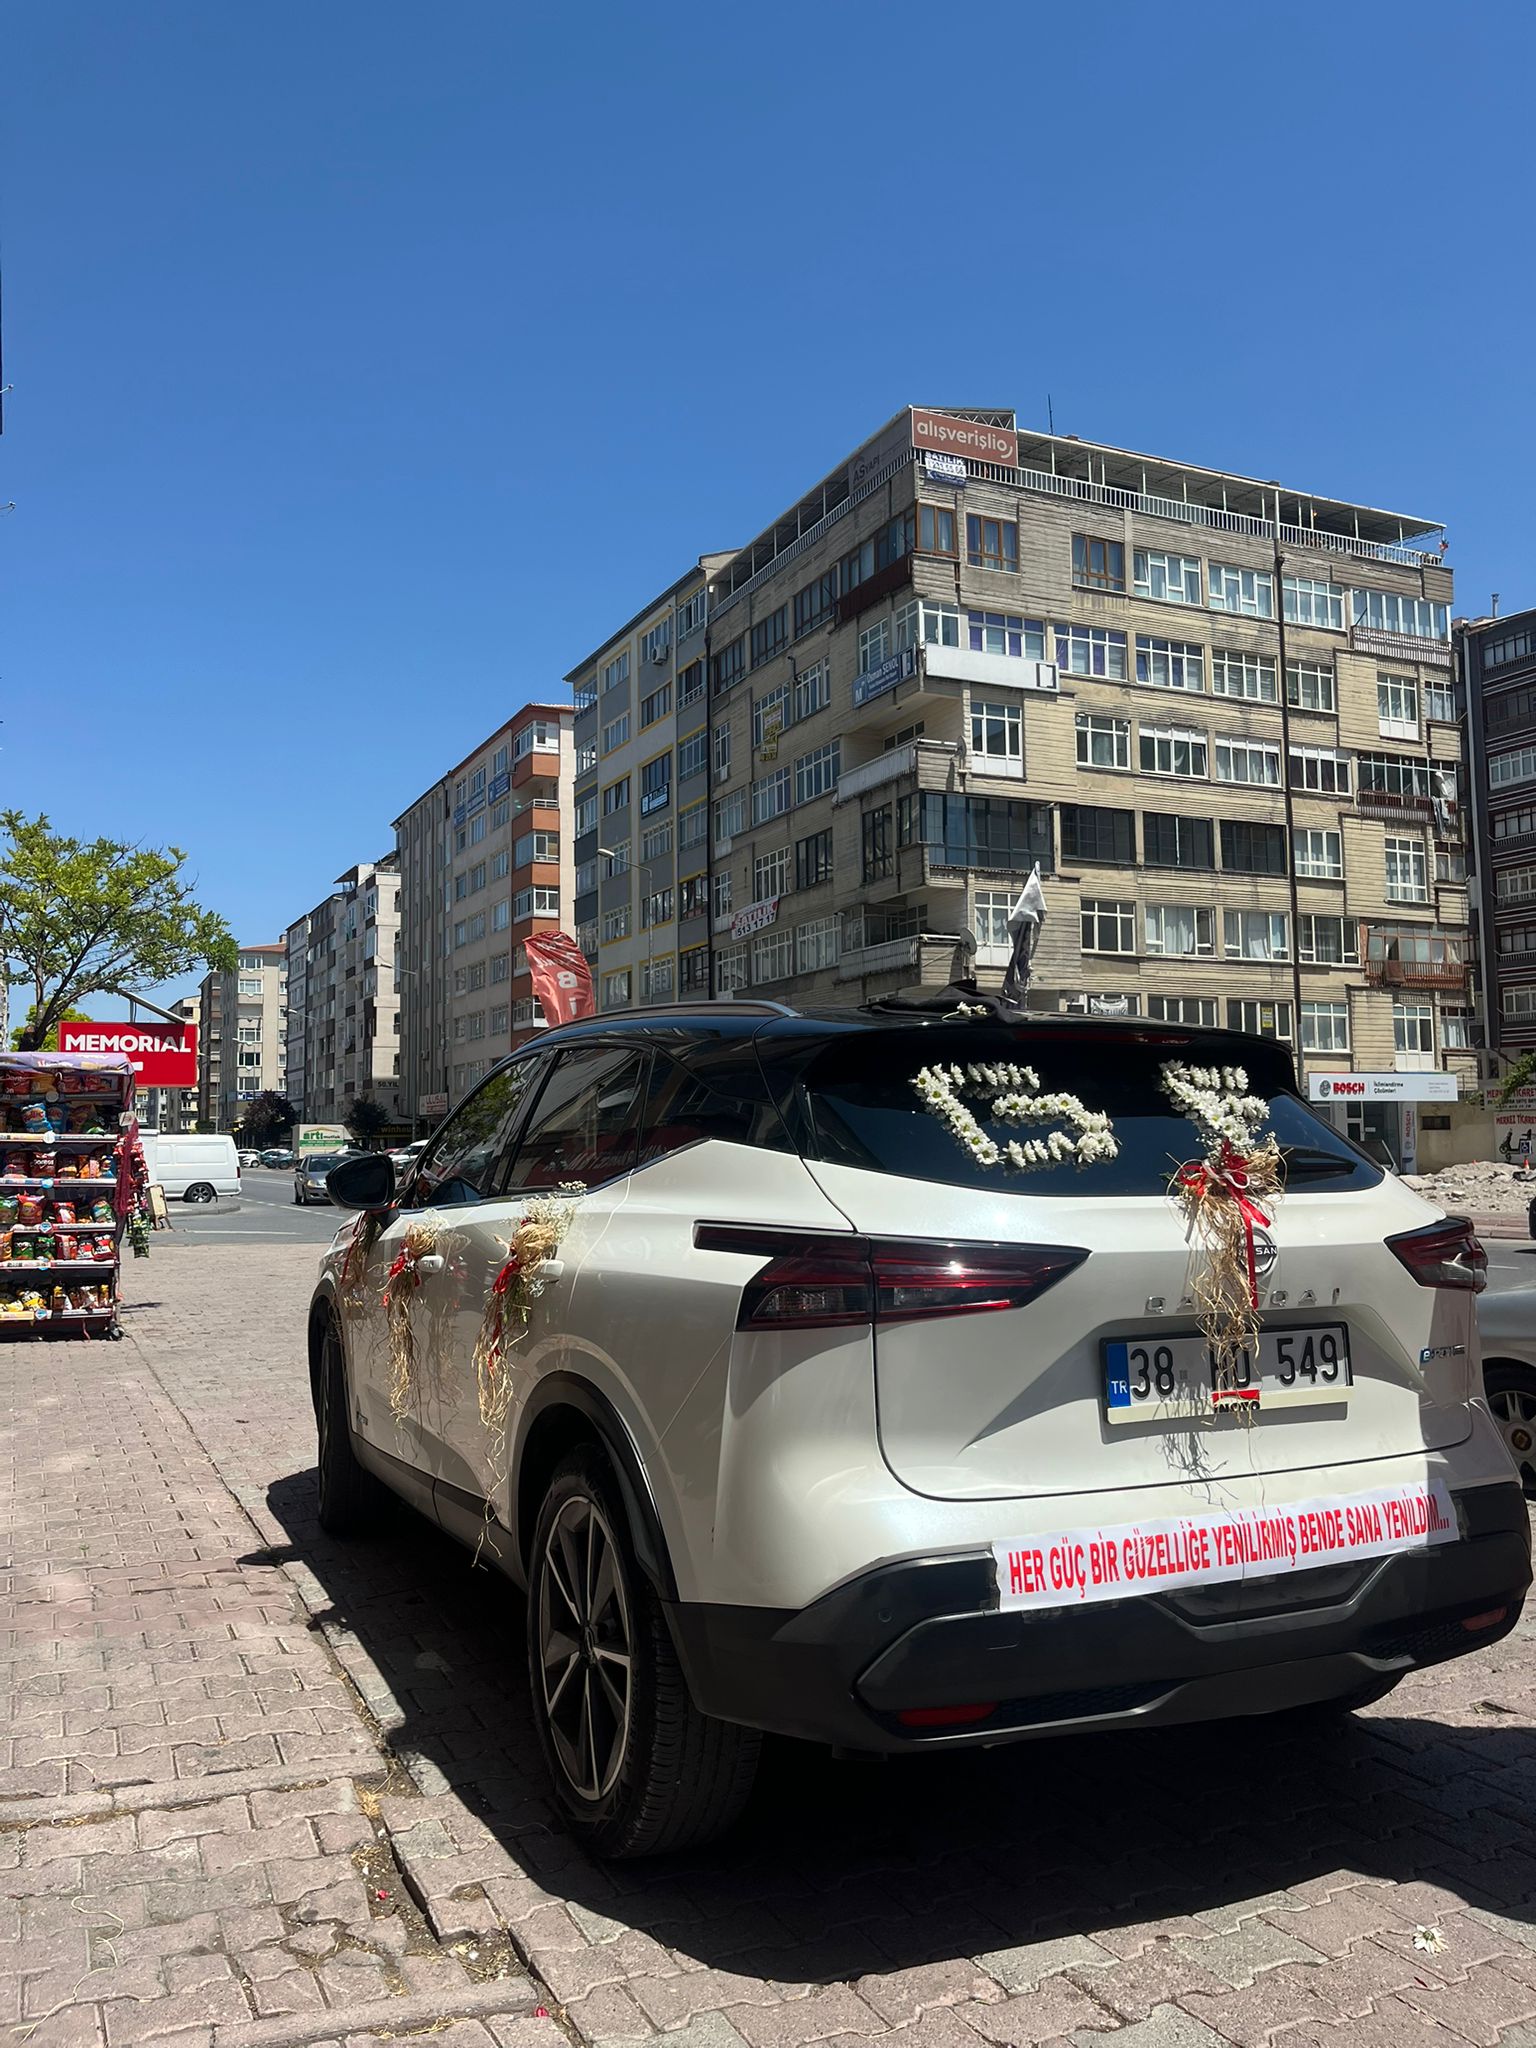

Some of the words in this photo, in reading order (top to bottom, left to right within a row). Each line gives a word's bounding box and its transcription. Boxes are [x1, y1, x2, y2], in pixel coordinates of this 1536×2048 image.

[737, 923, 751, 937] 513
[753, 917, 764, 929] 17
[766, 912, 775, 923] 17
[65, 1034, 191, 1053] MEMORIAL
[1333, 1082, 1364, 1094] BOSCH
[1147, 1287, 1341, 1315] QAQAI
[1130, 1346, 1175, 1400] 38
[1276, 1334, 1339, 1386] 549
[1111, 1380, 1128, 1394] TR
[1008, 1549, 1047, 1595] HER
[1050, 1536, 1087, 1598] GÜÇ
[1089, 1531, 1120, 1584] BİR
[1122, 1520, 1211, 1580] GÜZELLİĞE
[1298, 1509, 1345, 1554] BENDE
[1345, 1503, 1383, 1546] SANA
